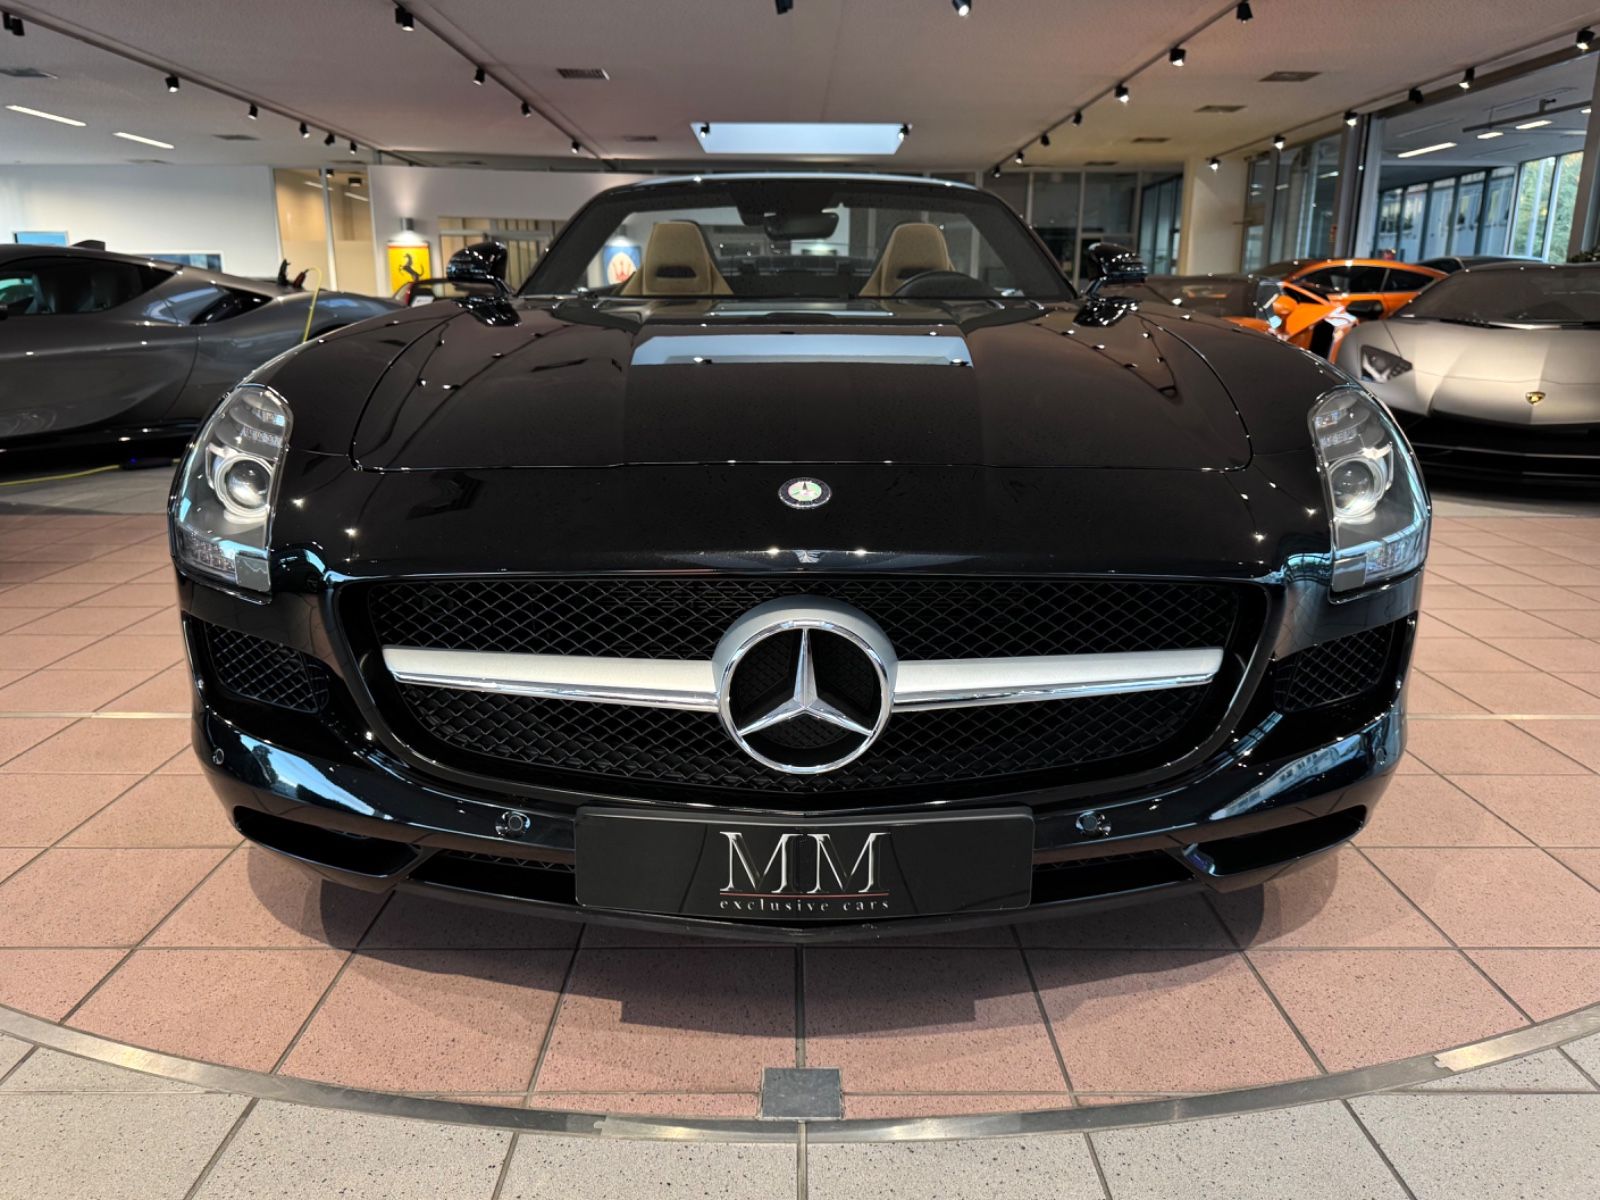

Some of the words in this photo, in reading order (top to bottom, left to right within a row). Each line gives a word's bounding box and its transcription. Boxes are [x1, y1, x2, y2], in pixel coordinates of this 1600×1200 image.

[719, 831, 891, 894] MM
[719, 898, 829, 912] exclusive
[843, 899, 889, 912] cars
